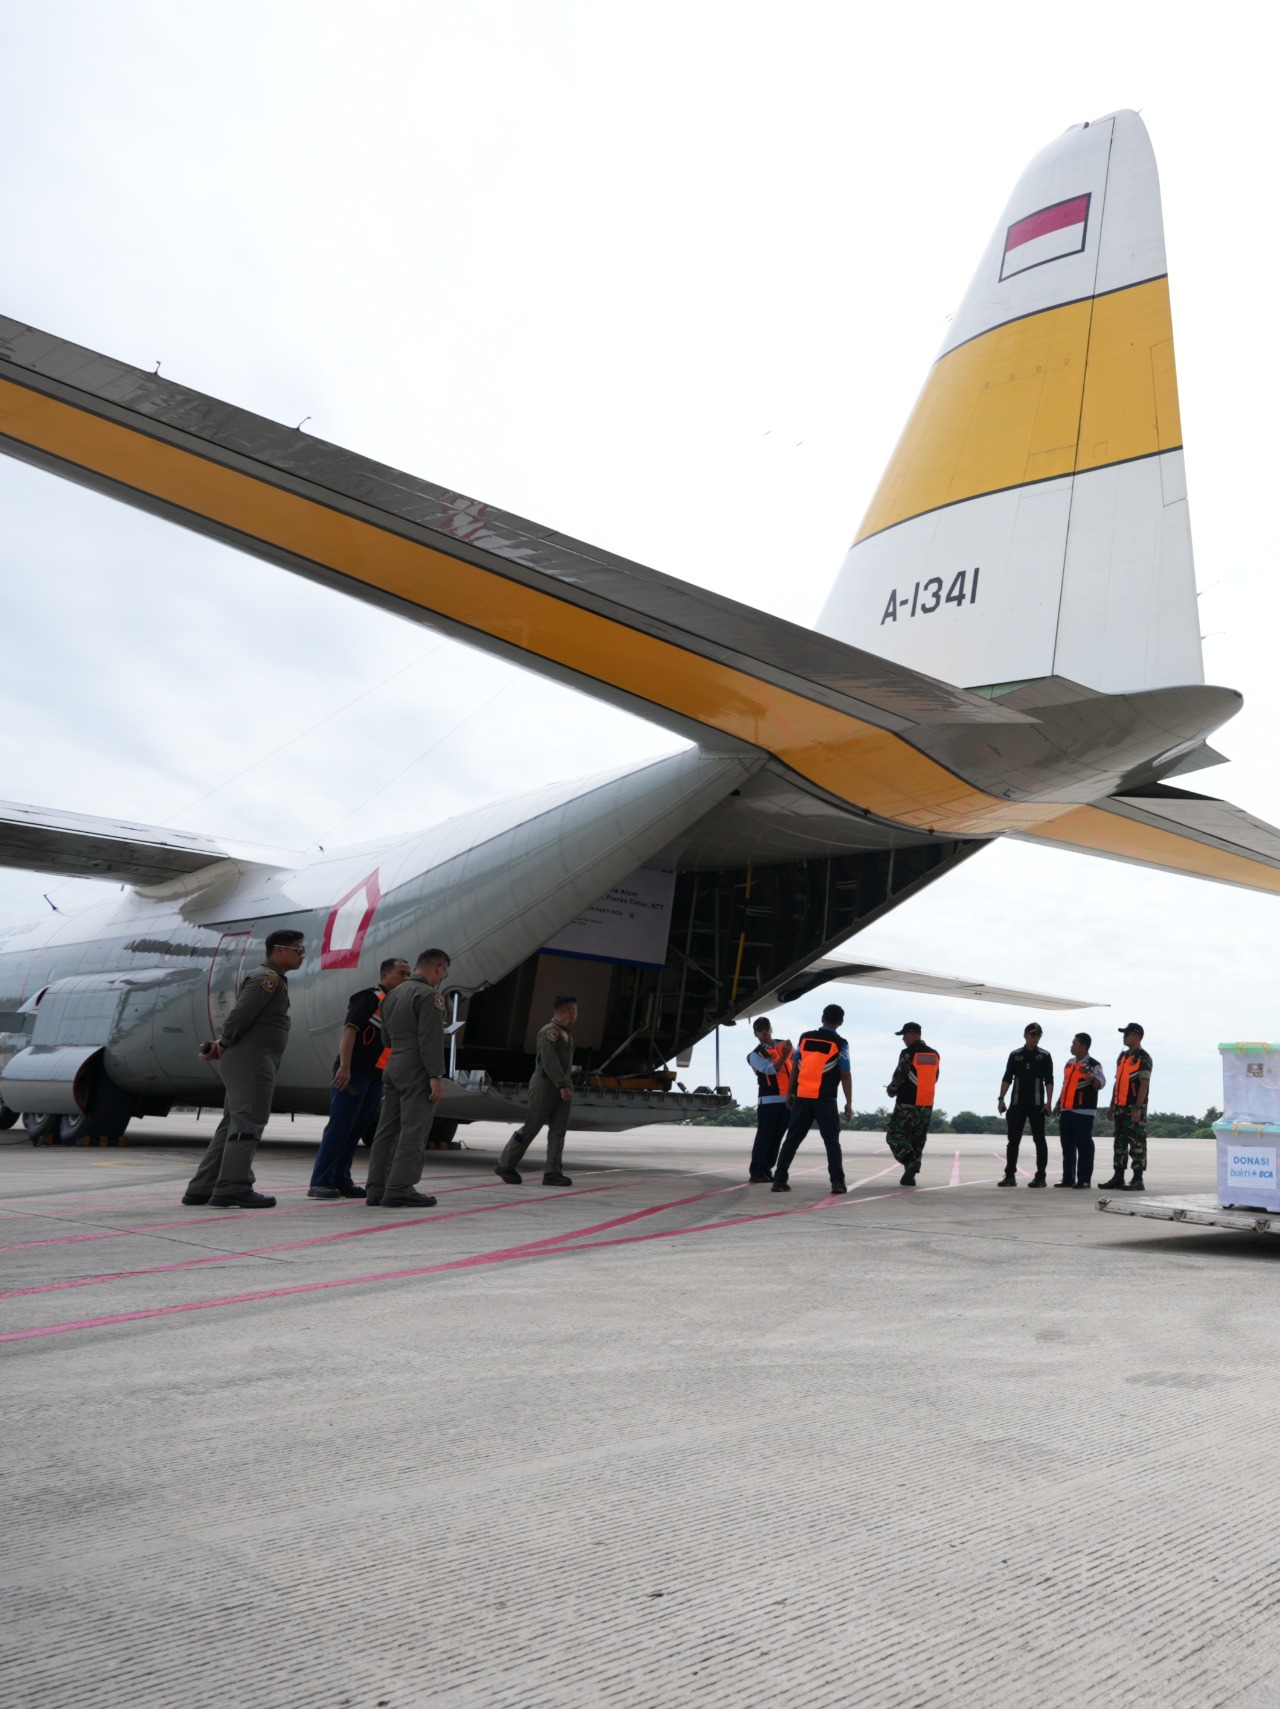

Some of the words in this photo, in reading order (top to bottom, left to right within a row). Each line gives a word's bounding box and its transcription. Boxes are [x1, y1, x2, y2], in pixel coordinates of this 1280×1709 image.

[880, 567, 980, 626] A-1341
[620, 888, 639, 898] Alam
[606, 894, 628, 904] Flores
[650, 902, 665, 911] NTT
[1233, 1155, 1270, 1166] DONASI
[1229, 1167, 1251, 1178] bakti
[1258, 1170, 1274, 1179] BCA
